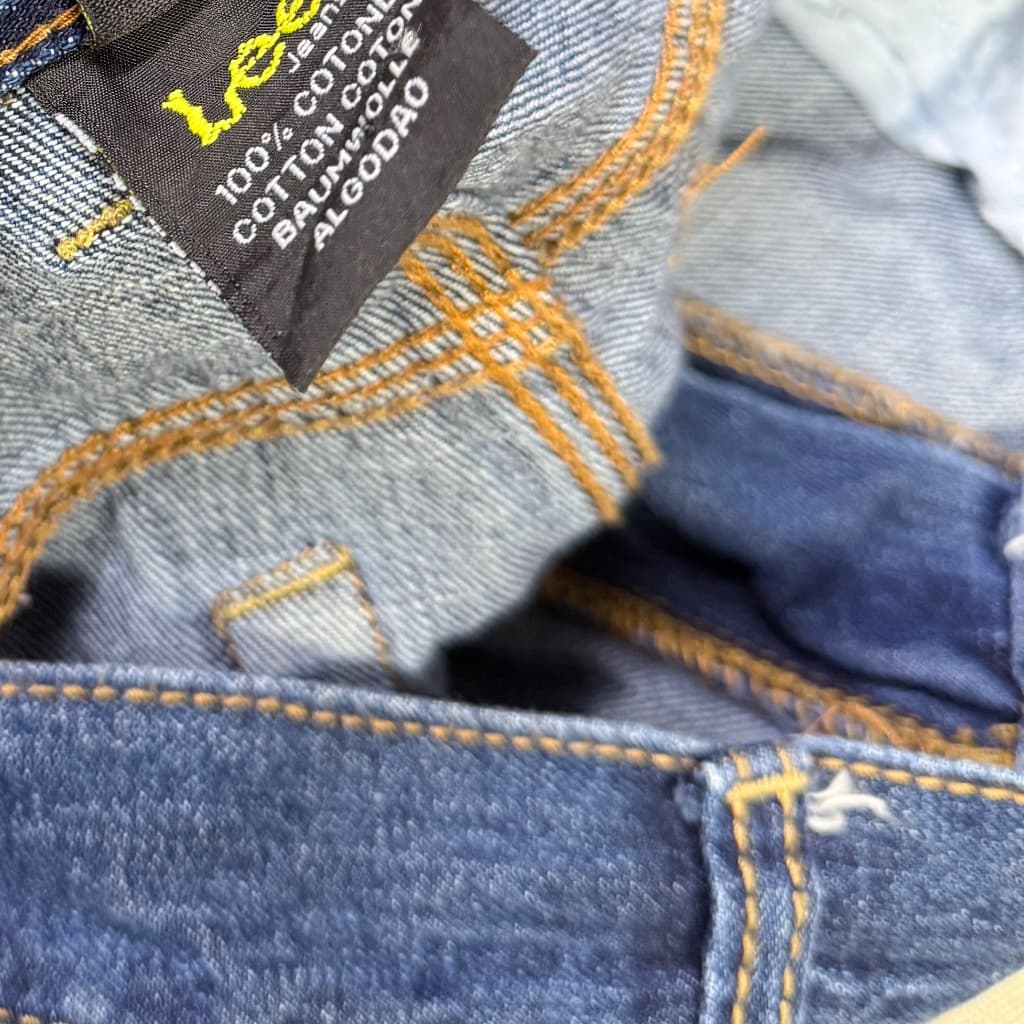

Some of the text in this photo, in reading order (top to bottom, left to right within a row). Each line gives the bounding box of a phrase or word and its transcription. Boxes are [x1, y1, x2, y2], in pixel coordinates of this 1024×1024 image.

[214, 122, 294, 206] 100%
[232, 112, 345, 245] COTTON
[312, 76, 430, 252] ALGODAO
